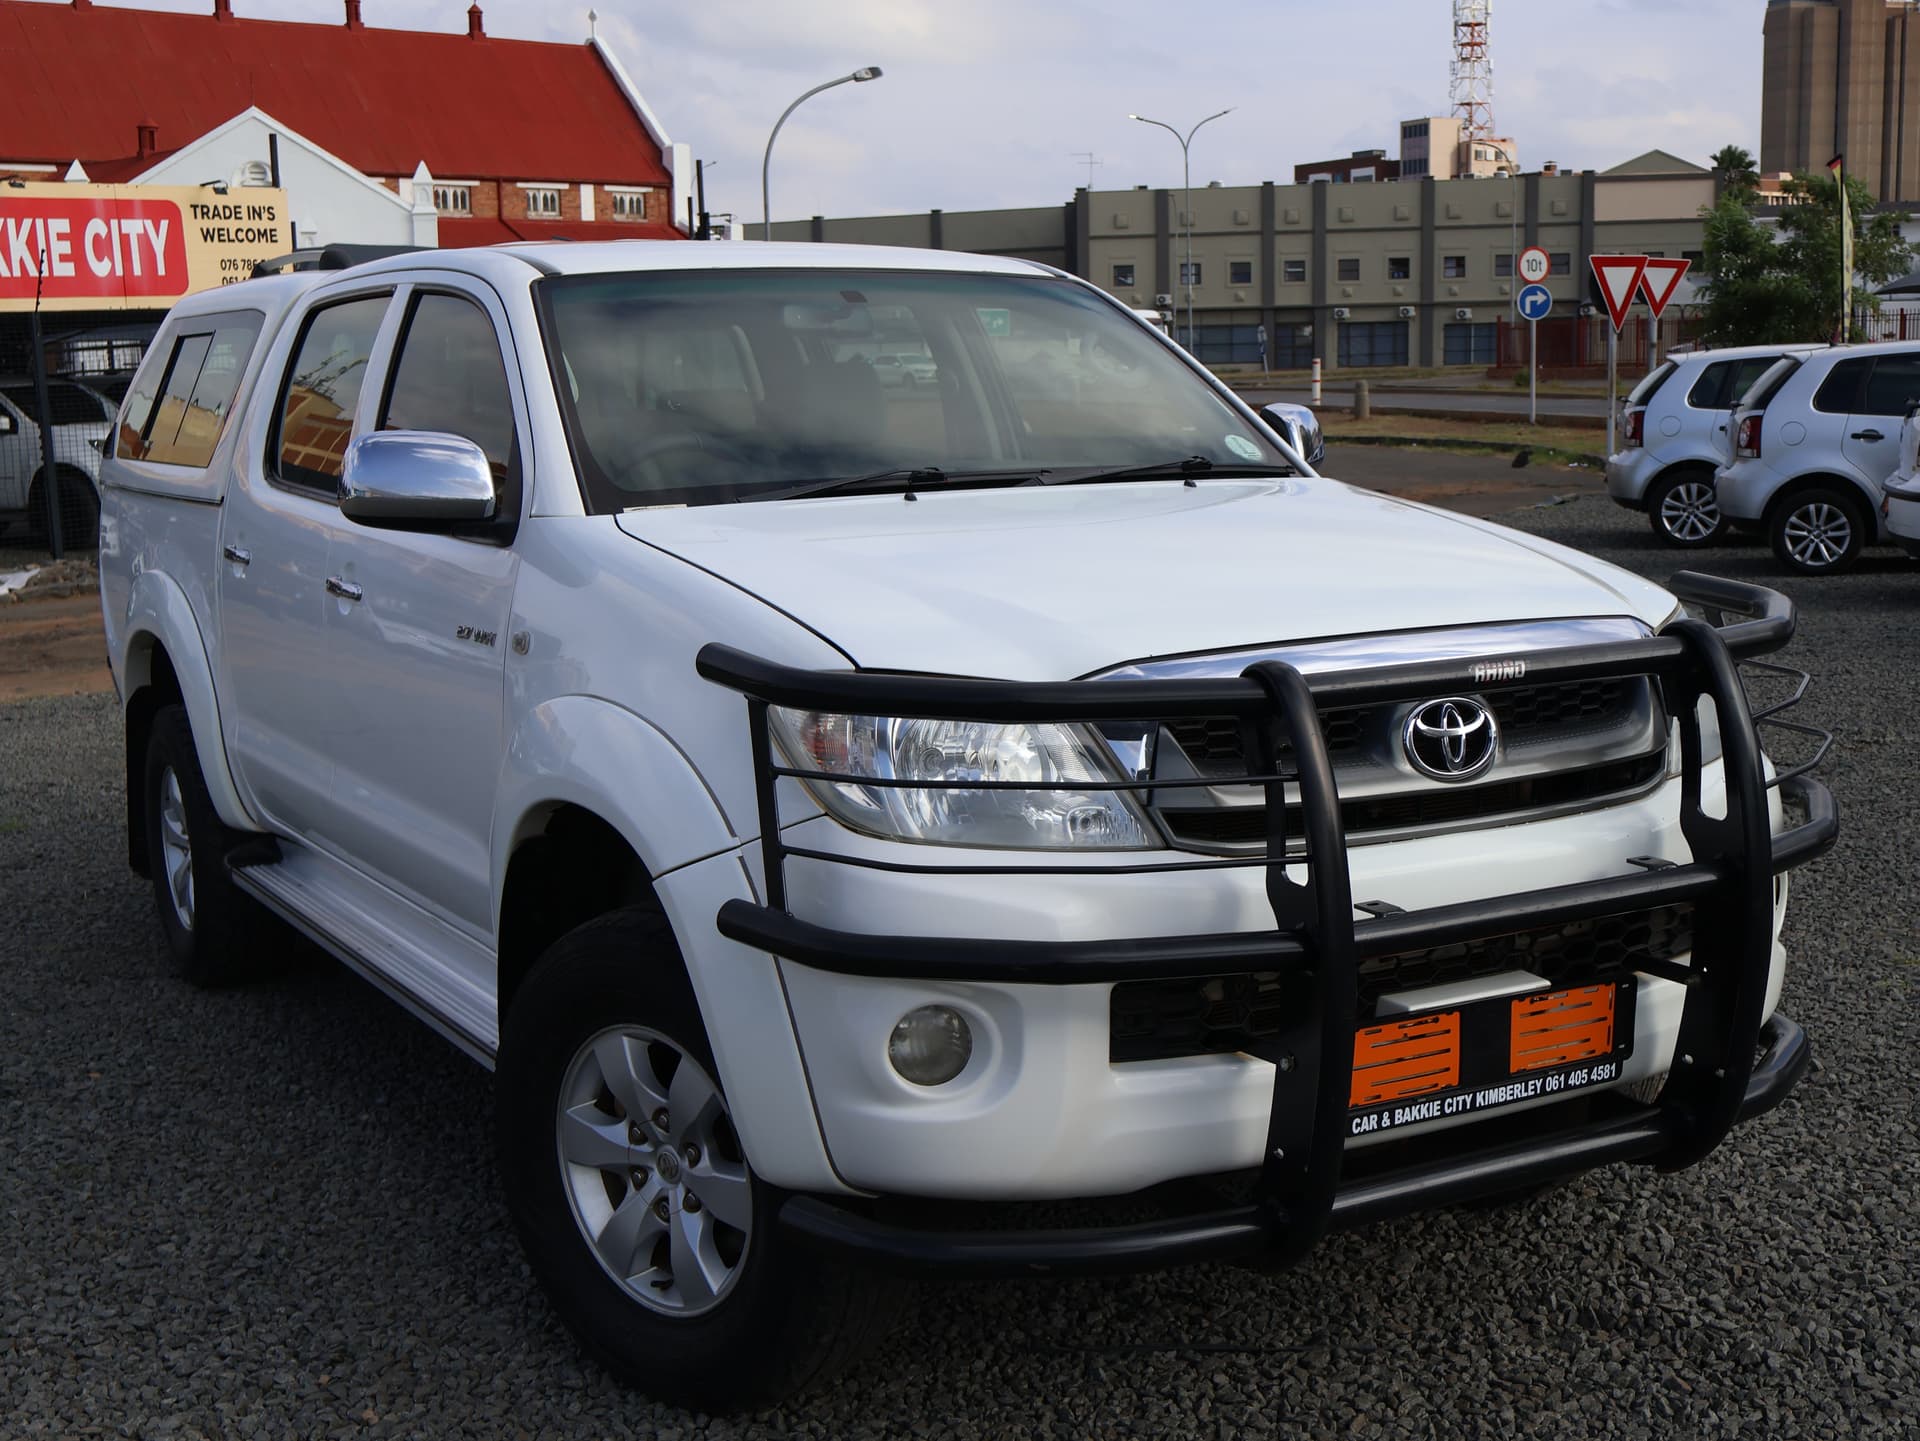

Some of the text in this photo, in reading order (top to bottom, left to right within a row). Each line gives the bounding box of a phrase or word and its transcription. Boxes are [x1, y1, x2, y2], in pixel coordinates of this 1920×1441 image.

[190, 204, 276, 221] TRADE IN'S
[200, 227, 279, 243] WELCOME
[84, 218, 169, 277] CITY
[220, 259, 239, 271] 076
[1526, 259, 1542, 272] 10t
[1352, 1062, 1616, 1134] CAR & BAKKIE CITY KIMBERLEY 061 405 4581
